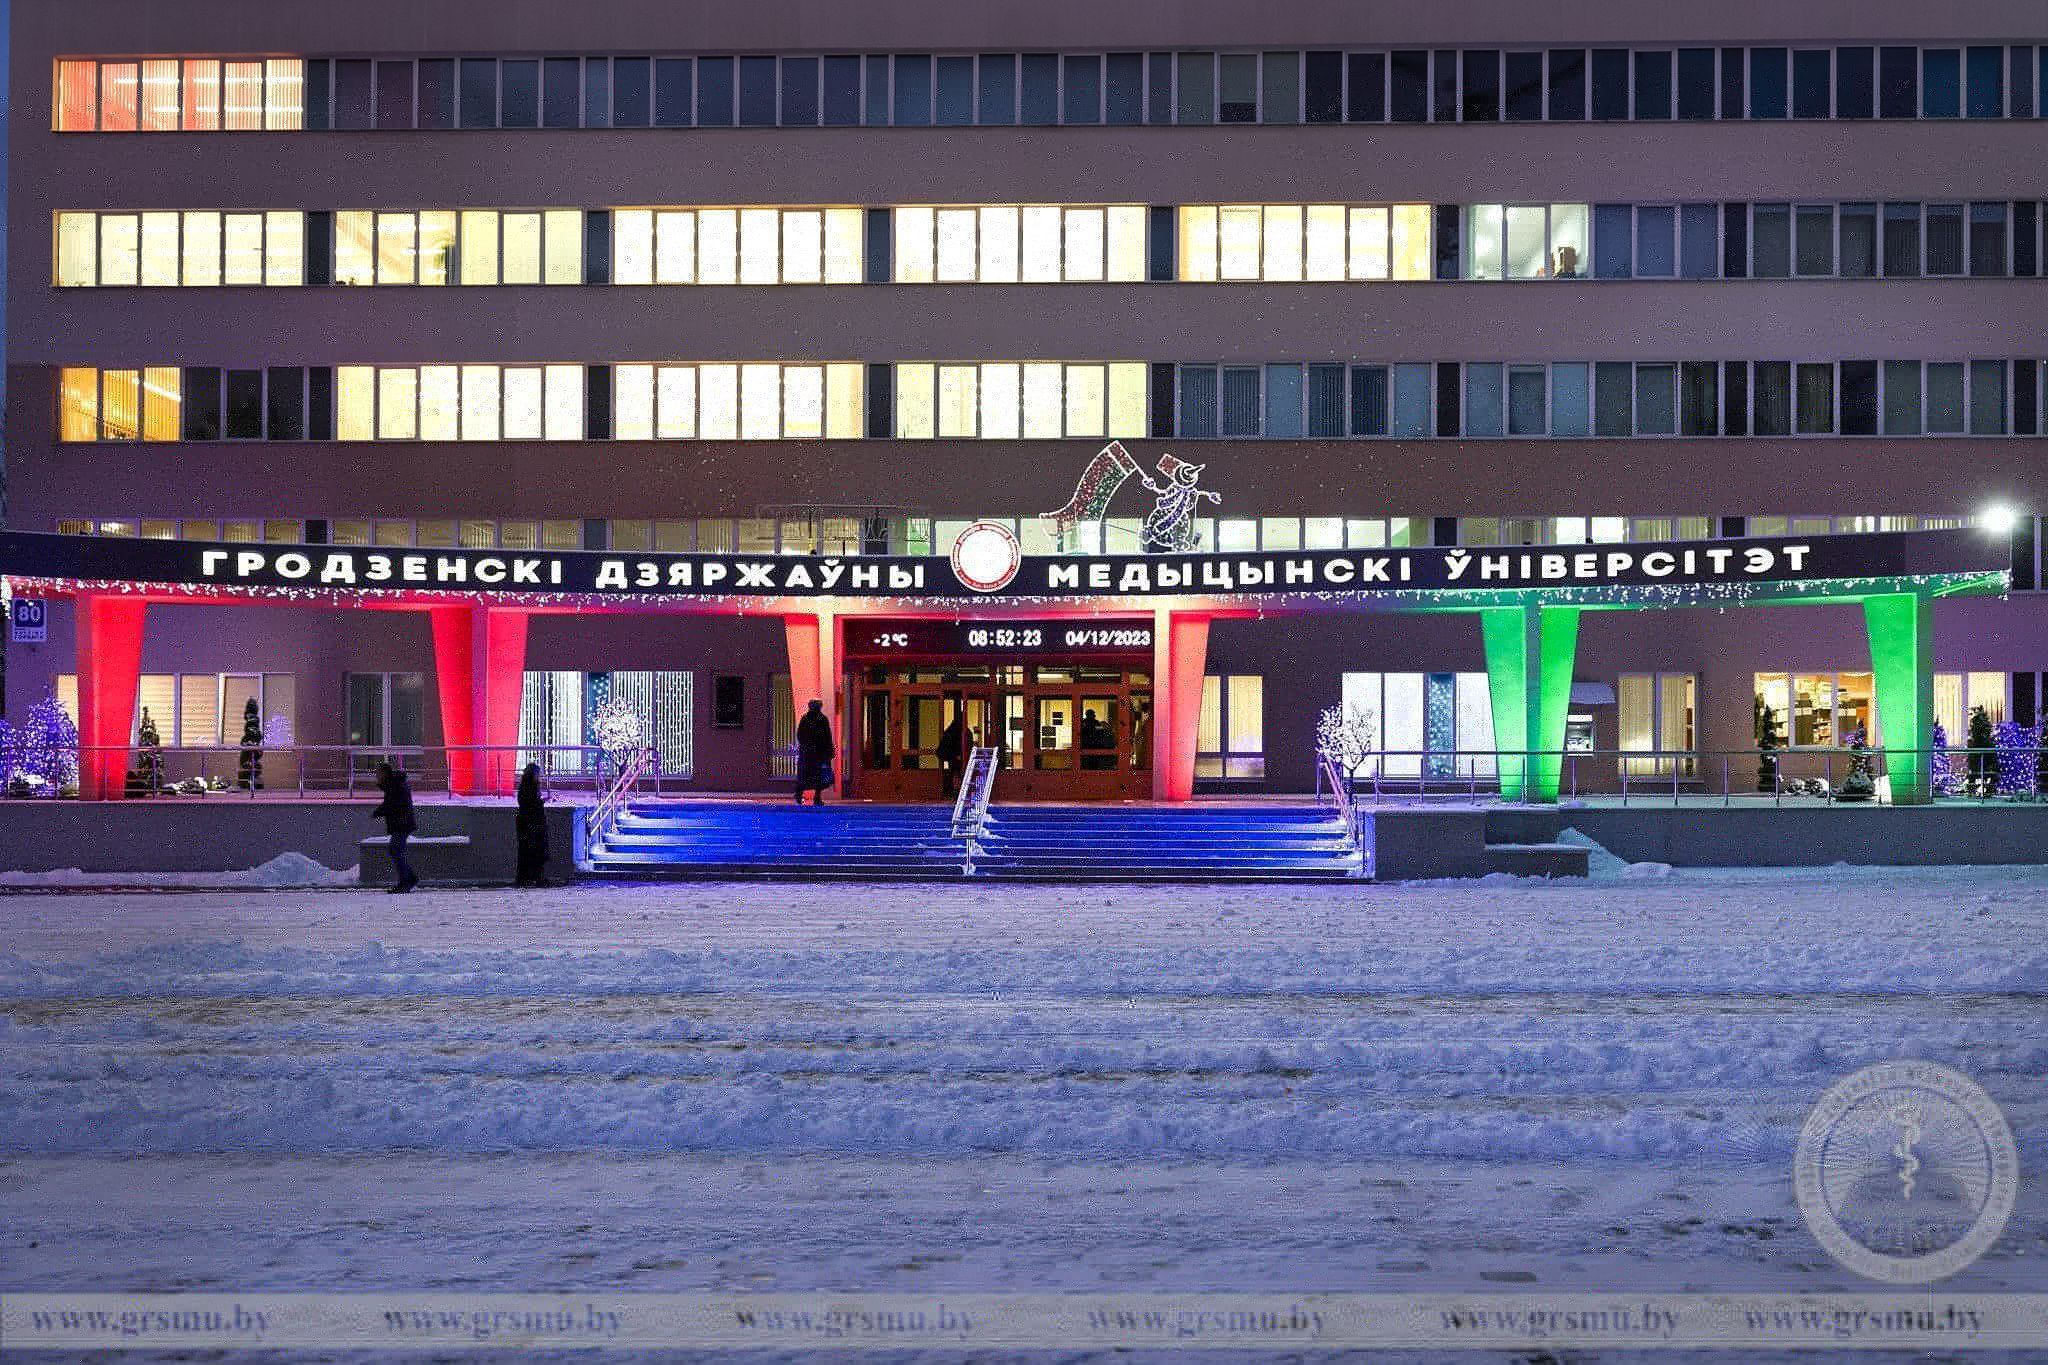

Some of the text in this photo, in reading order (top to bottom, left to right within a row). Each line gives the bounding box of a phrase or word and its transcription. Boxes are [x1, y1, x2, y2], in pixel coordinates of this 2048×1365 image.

[202, 550, 562, 584] ГРОДЗЕНСКІ
[595, 559, 925, 589] ДЗЯРЖАЎНЫ
[1049, 556, 1412, 592] МЕДЫЦЫНСКІ
[1444, 545, 1811, 580] ЎНІВЕРСІТЭТ
[18, 606, 41, 622] 80
[968, 630, 1042, 647] 08:52:23
[1065, 630, 1151, 647] 04/12/2023
